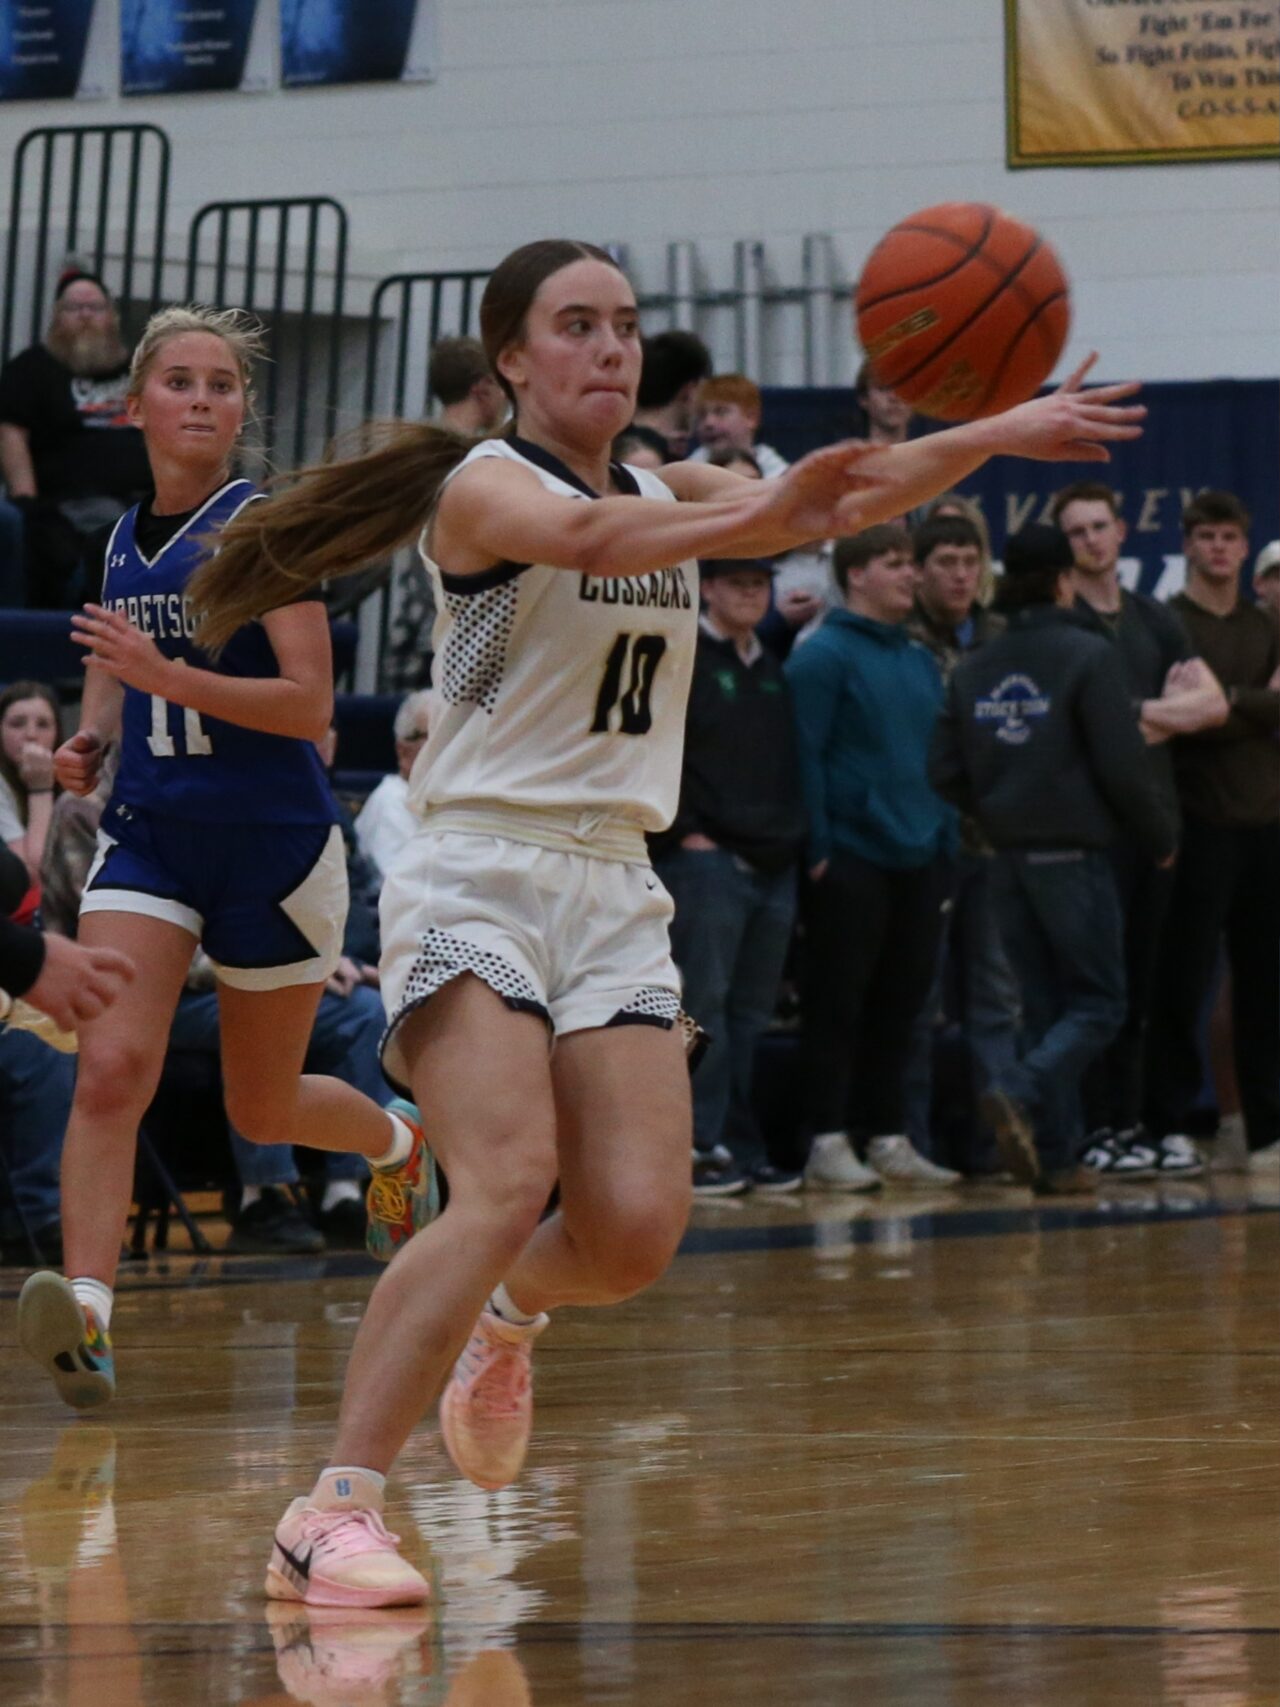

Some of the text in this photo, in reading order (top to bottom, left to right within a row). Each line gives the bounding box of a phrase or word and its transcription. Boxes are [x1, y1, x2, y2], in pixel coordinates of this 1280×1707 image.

[579, 567, 691, 609] COSSACKS
[147, 657, 213, 756] 11
[589, 633, 667, 735] 10
